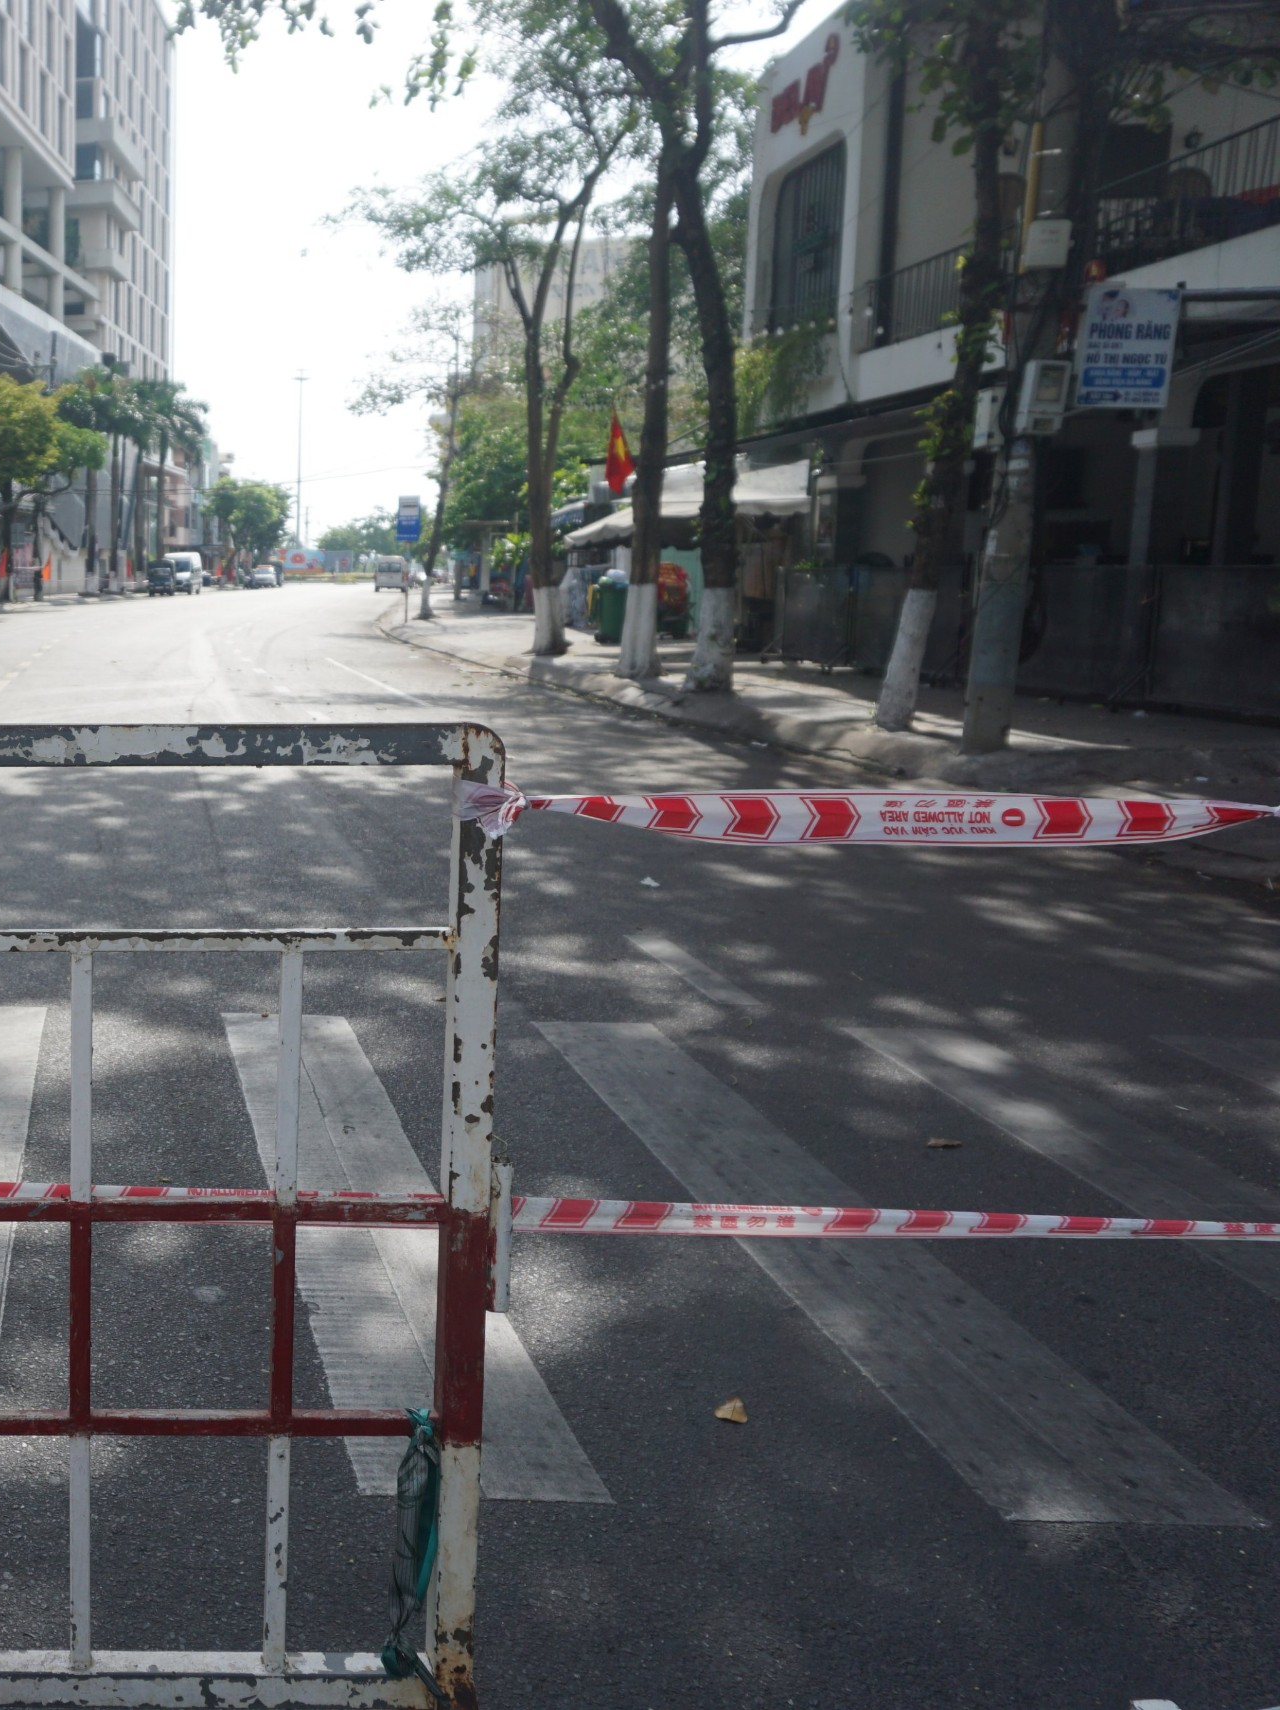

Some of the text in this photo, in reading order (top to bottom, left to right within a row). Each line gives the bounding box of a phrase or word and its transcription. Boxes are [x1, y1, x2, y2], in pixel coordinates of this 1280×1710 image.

[879, 810, 991, 824] NOT ALLOWED AREA
